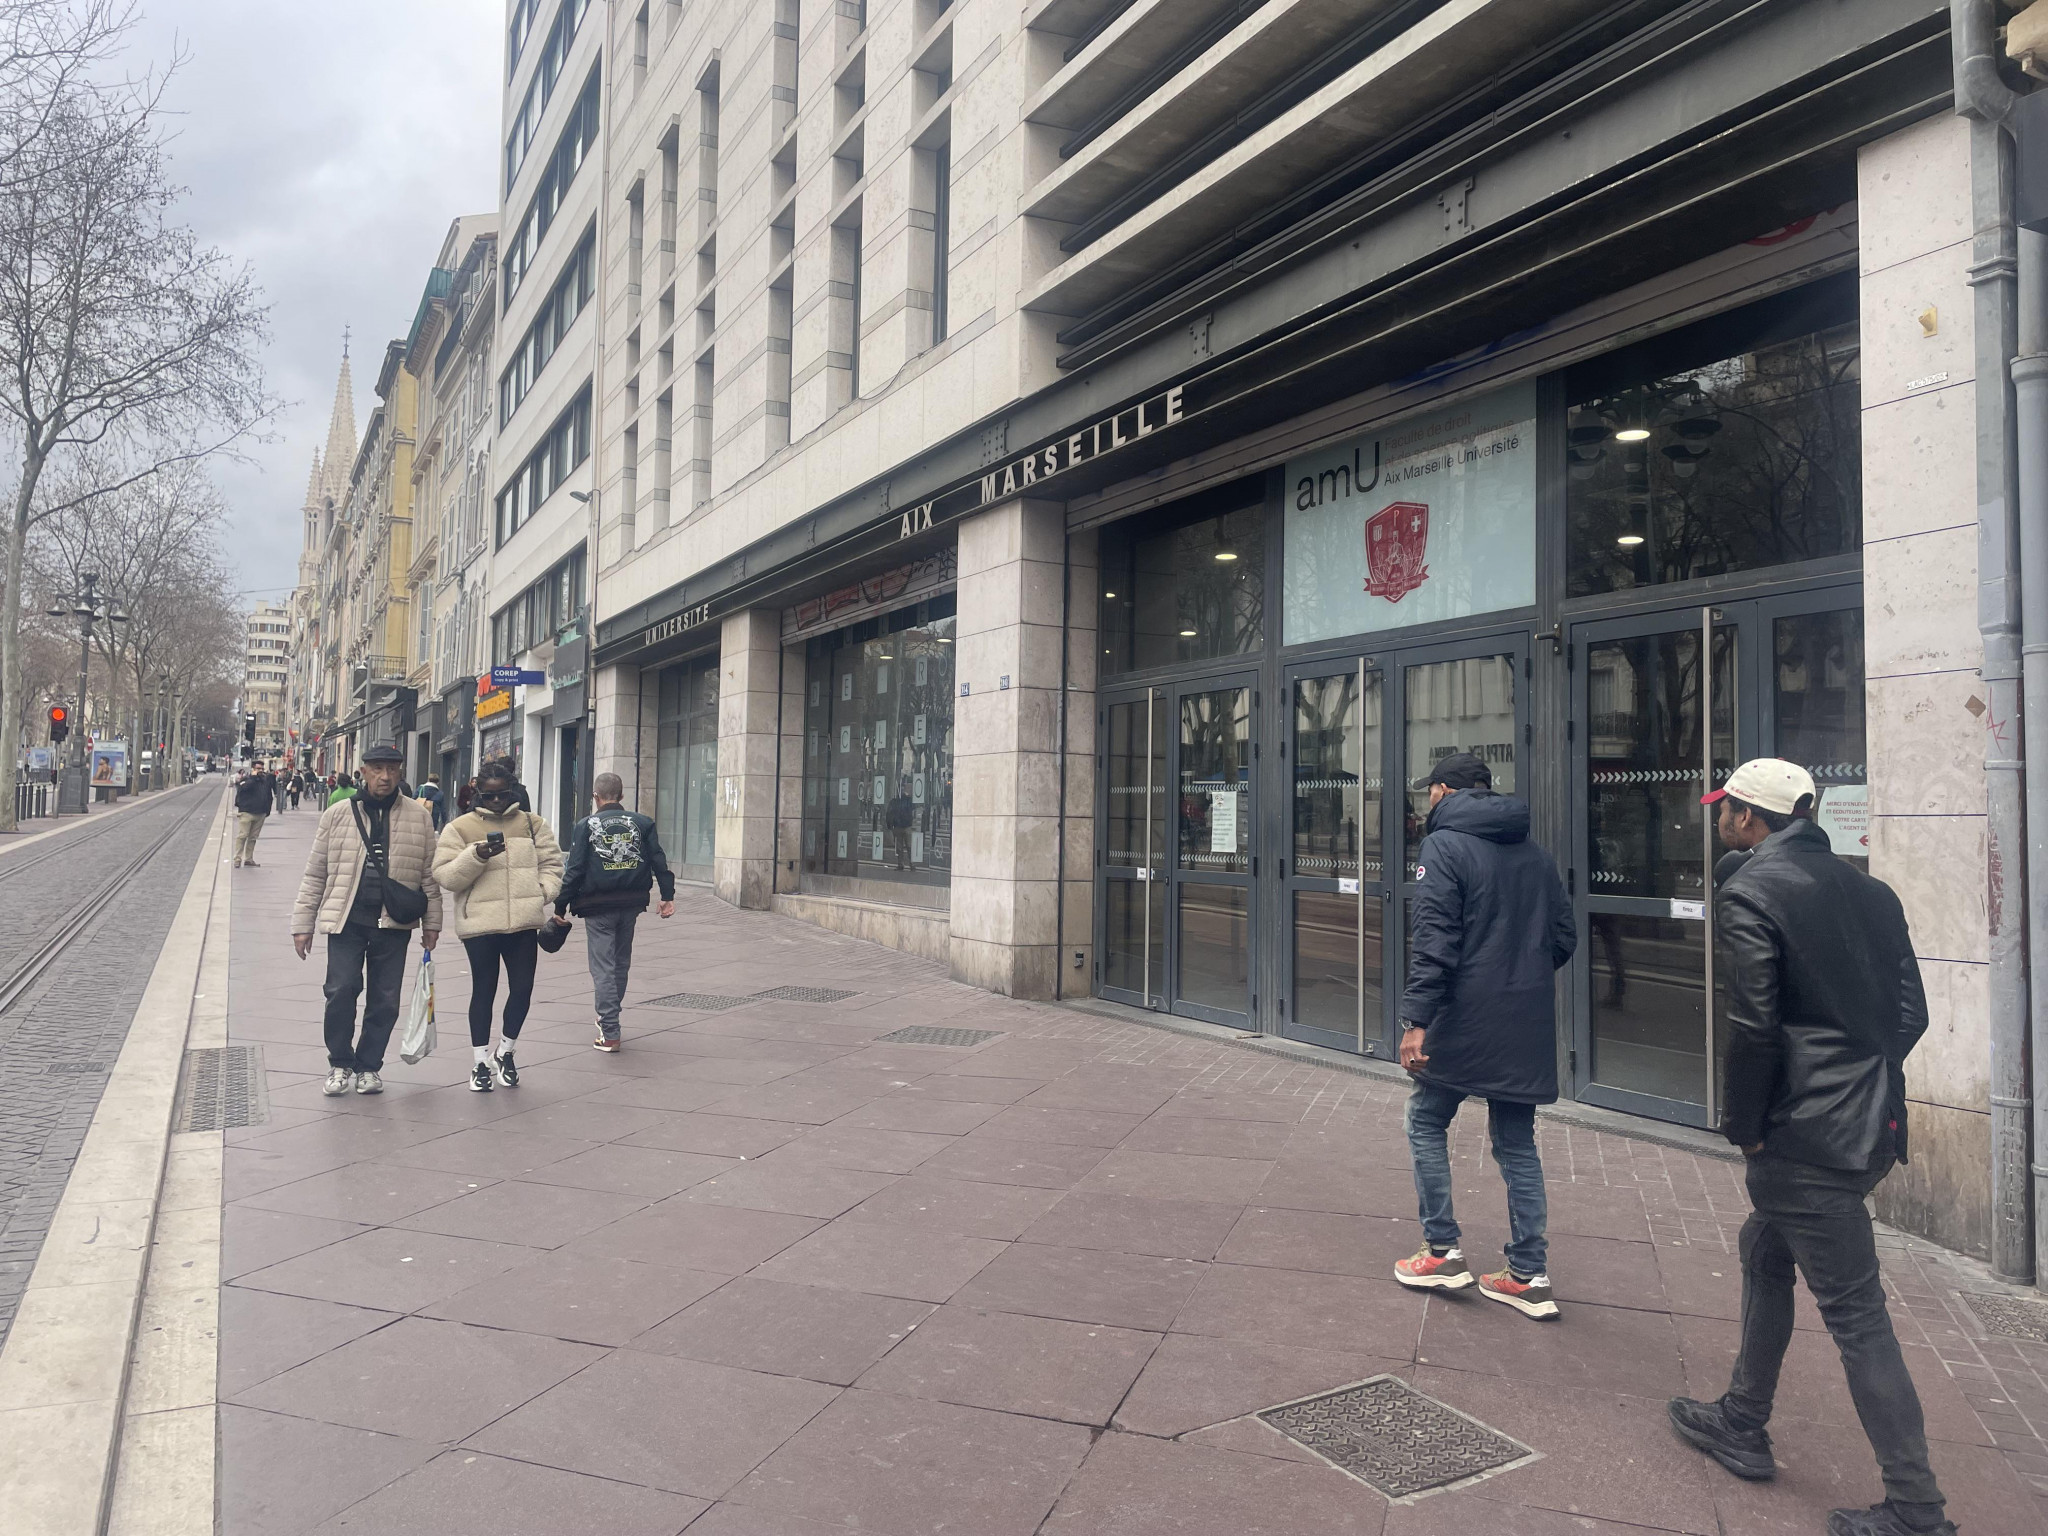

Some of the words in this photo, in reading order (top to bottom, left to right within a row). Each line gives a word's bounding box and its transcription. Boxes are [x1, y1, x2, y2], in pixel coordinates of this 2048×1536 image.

[1427, 422, 1442, 438] de
[1444, 411, 1472, 432] droit
[1296, 441, 1380, 511] amU
[1384, 471, 1401, 486] Aix
[1403, 453, 1454, 481] Marseille
[1457, 434, 1520, 464] Université
[645, 603, 709, 646] UNIVERSITE
[900, 500, 935, 539] AIX
[981, 385, 1183, 505] MARSEILLE
[494, 669, 519, 677] COREP
